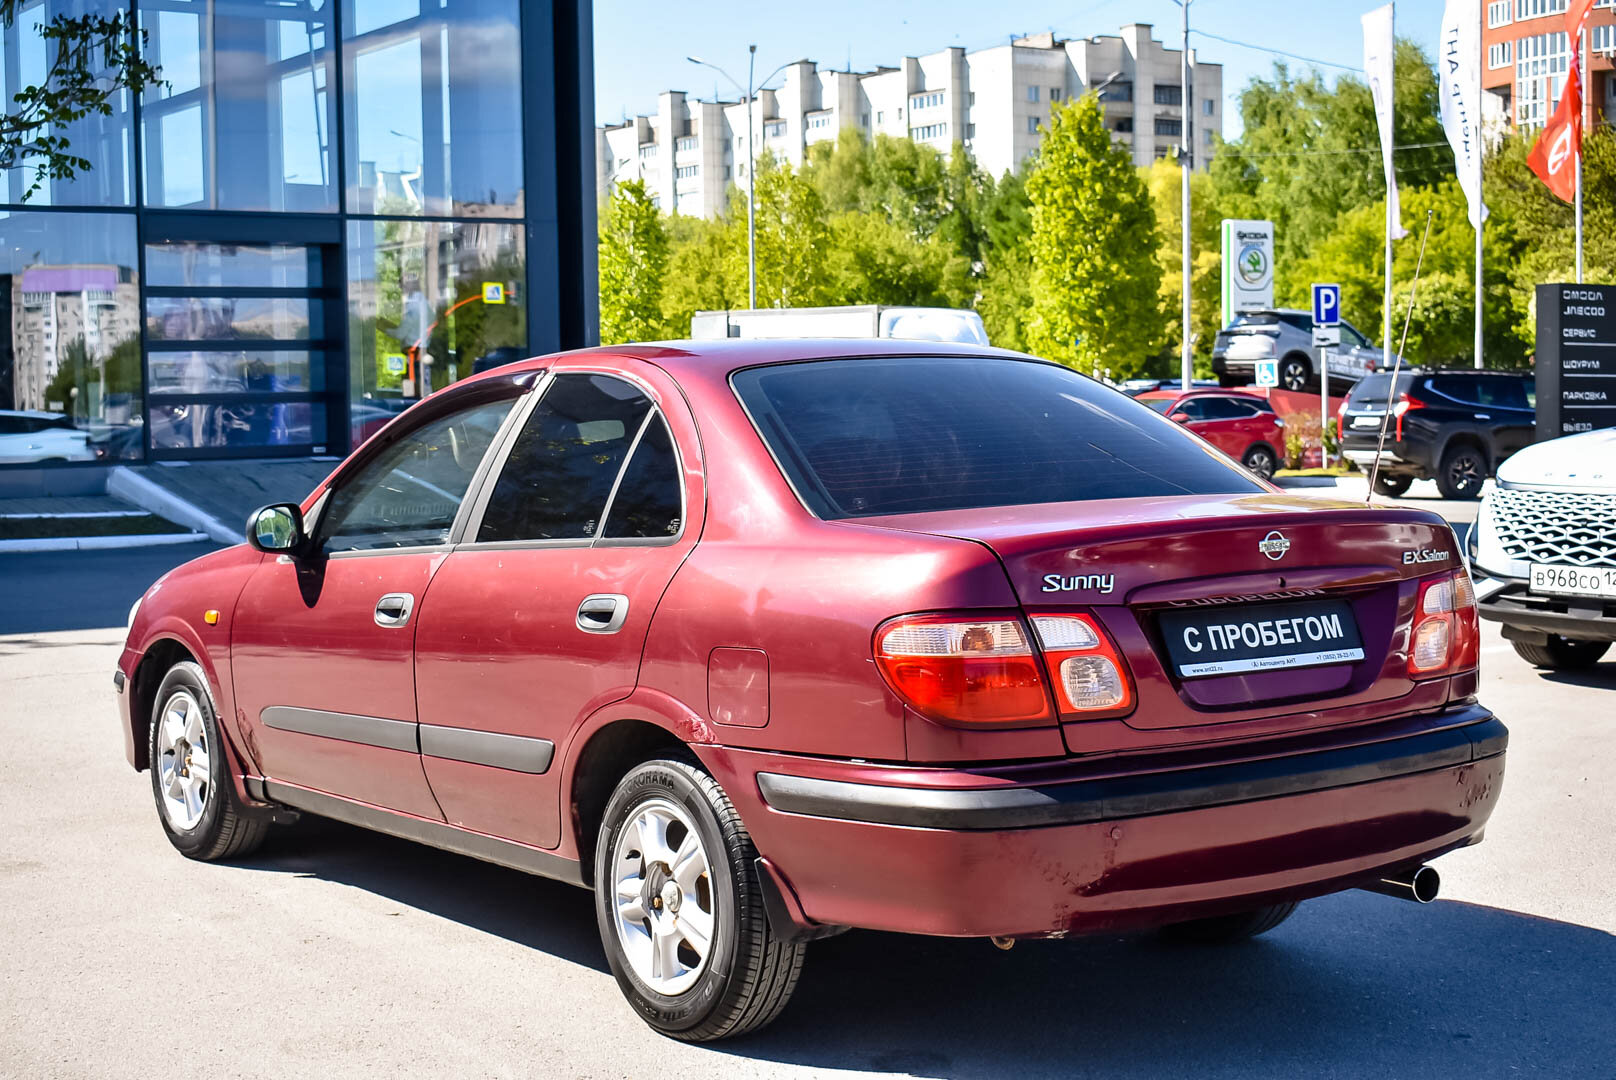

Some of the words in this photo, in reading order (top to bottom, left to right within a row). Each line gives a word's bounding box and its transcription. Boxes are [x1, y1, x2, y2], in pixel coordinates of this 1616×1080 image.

[1320, 288, 1336, 321] P
[1563, 328, 1597, 338] СЕРВИС
[1563, 360, 1600, 370] ШОУРУМ
[1563, 391, 1607, 401] ПАРКОВКА
[1563, 423, 1593, 432] ВЫЕЗД
[1042, 574, 1114, 594] Sunny
[1182, 627, 1203, 653] С
[1207, 613, 1344, 651] ПРОБЕГОМ
